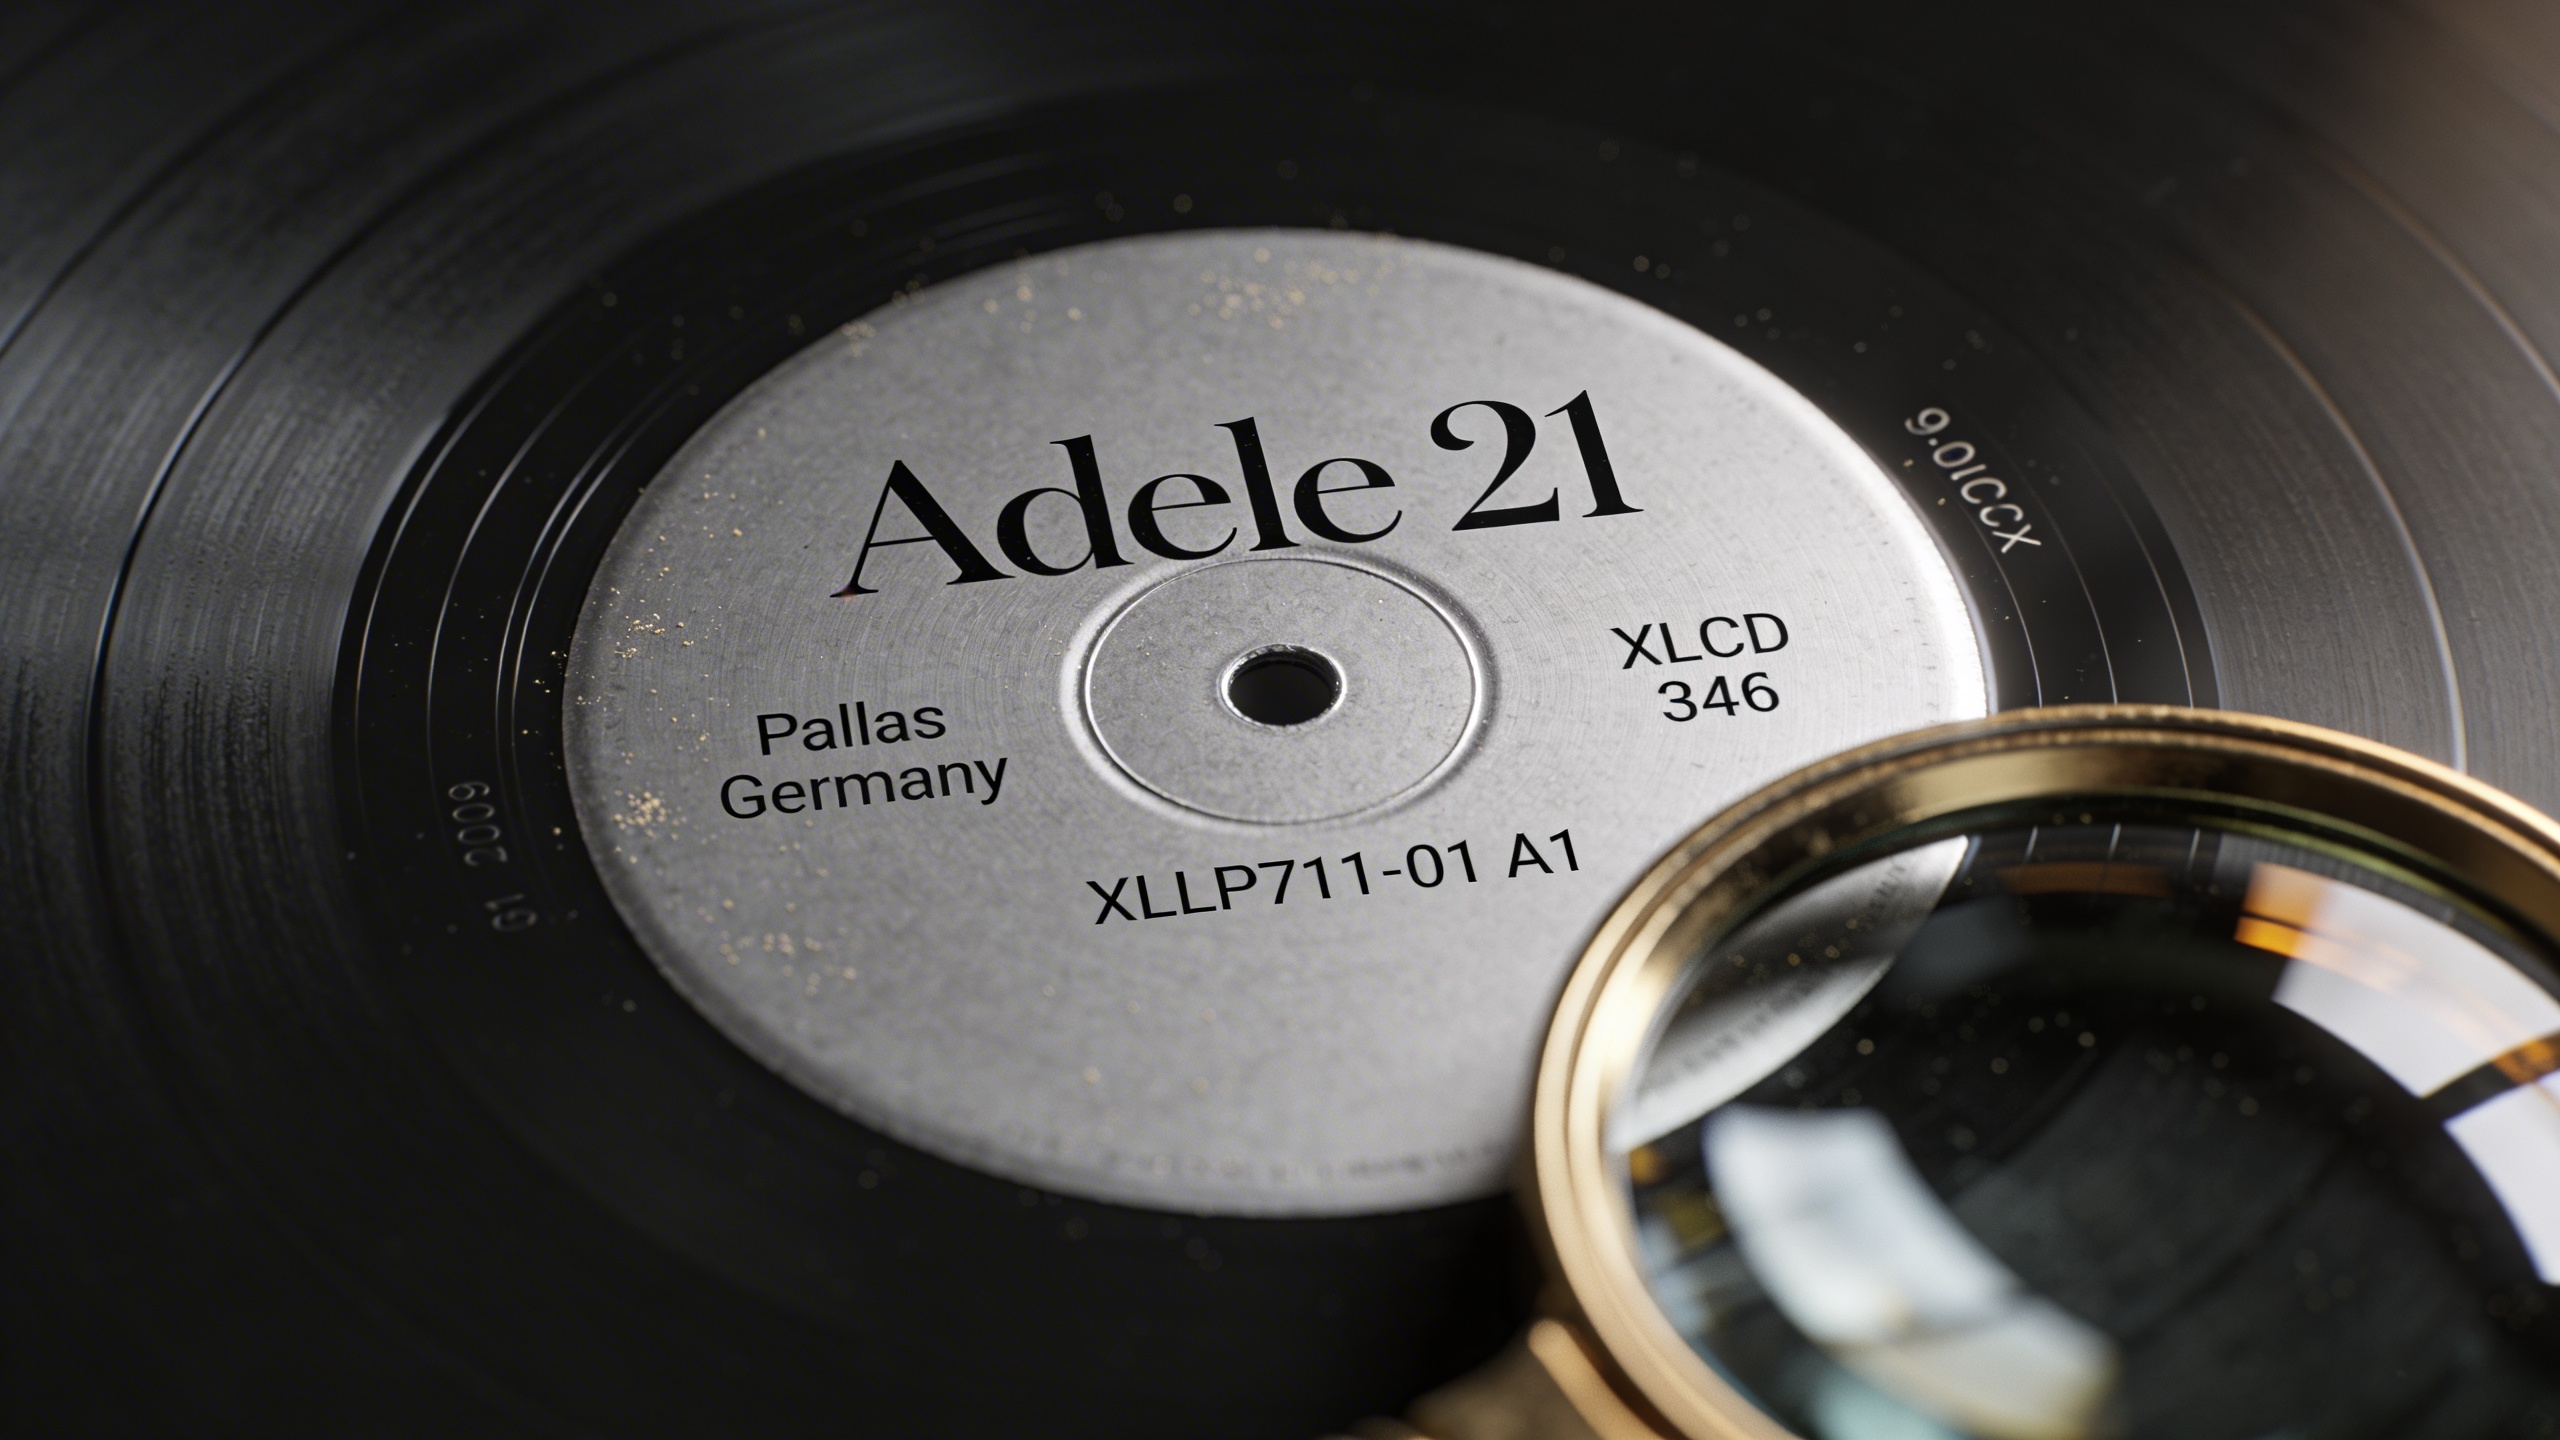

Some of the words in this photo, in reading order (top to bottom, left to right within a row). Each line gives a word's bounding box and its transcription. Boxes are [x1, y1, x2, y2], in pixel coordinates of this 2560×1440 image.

[829, 416, 1402, 599] Adele
[1430, 389, 1645, 532] 21
[1610, 613, 1789, 670] XLCD
[1658, 671, 1780, 722] 346
[756, 700, 946, 757] Pallas
[720, 757, 1008, 820] Germany
[1085, 839, 1478, 926] XLLP711-01
[1507, 828, 1580, 879] A1
